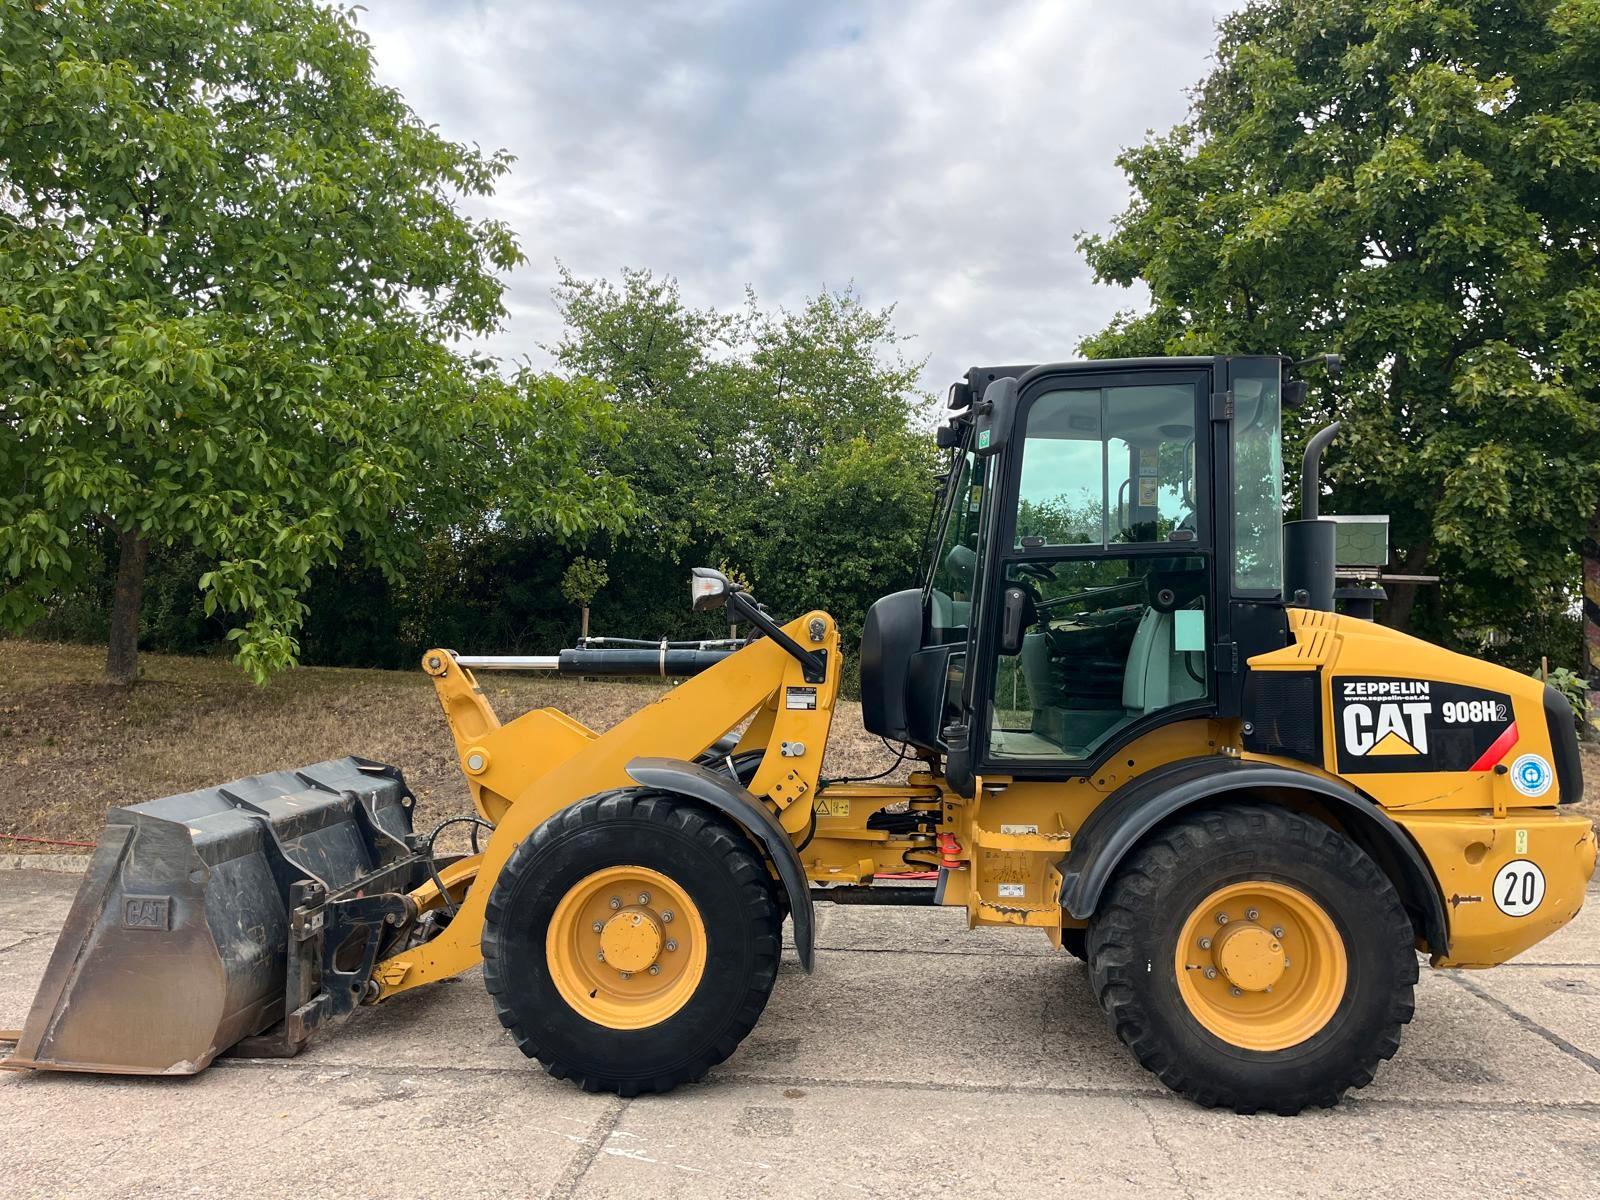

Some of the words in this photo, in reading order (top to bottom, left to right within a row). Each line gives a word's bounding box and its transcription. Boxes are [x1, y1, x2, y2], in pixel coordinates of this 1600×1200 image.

[1343, 682, 1430, 695] ZEPPELIN
[1343, 703, 1432, 756] CAT
[1503, 871, 1536, 906] 20
[126, 900, 163, 926] CAT
